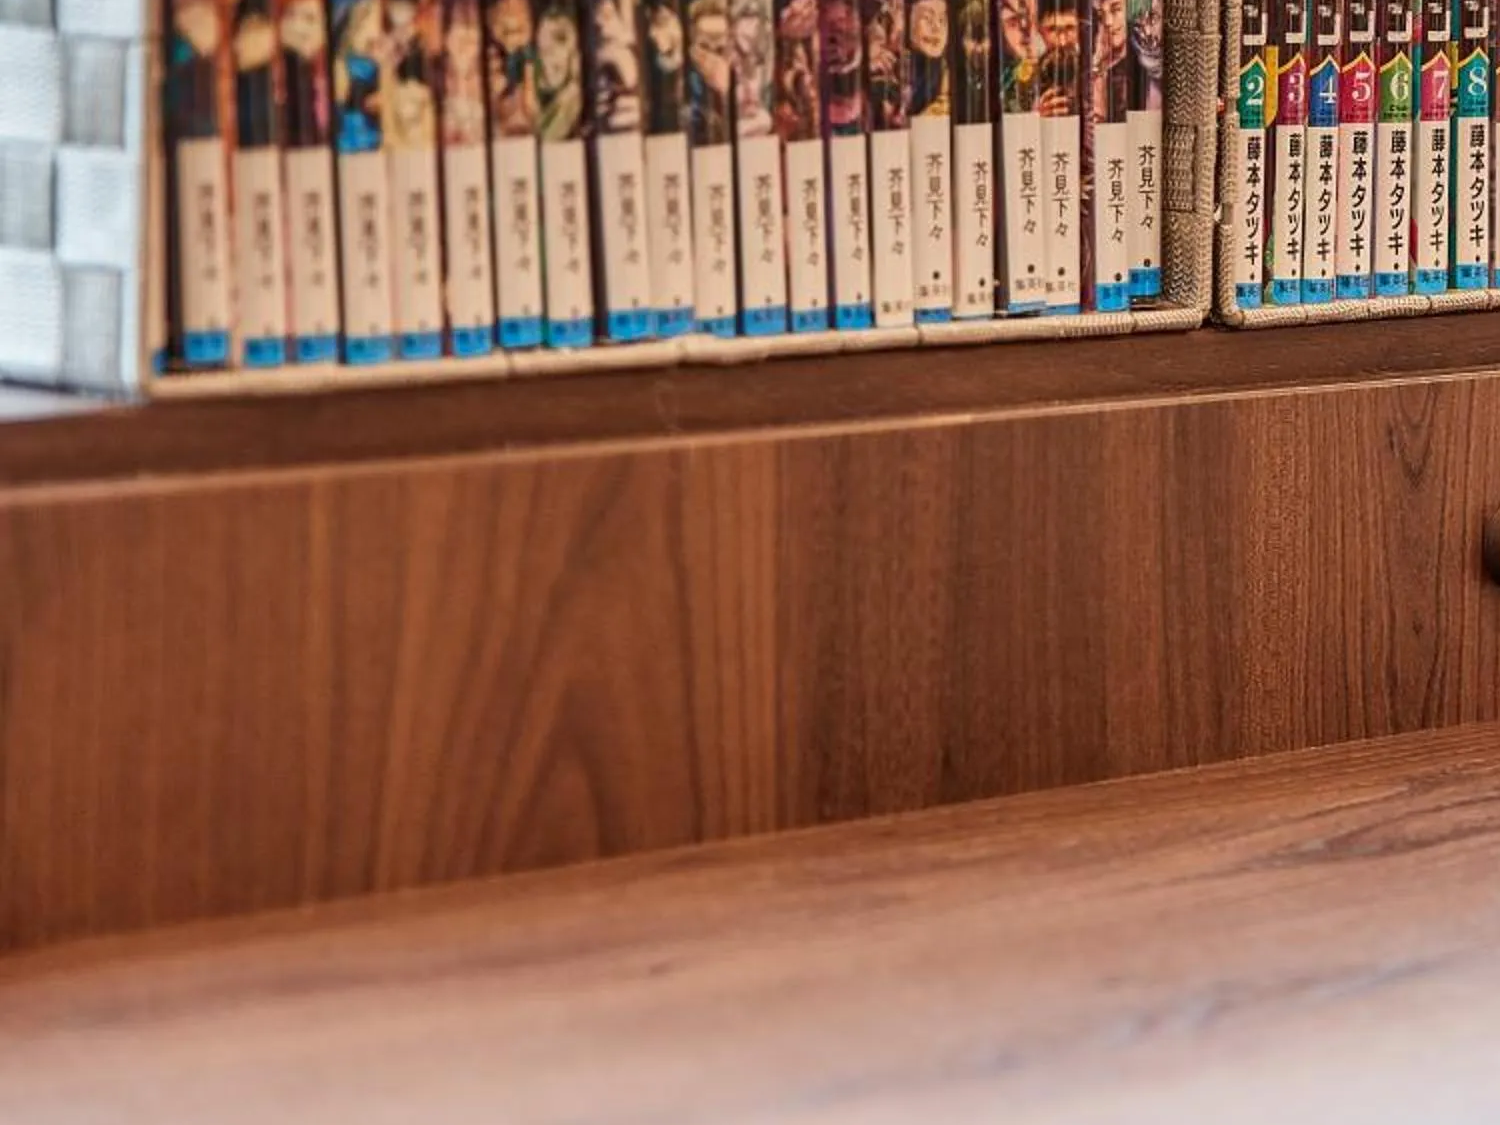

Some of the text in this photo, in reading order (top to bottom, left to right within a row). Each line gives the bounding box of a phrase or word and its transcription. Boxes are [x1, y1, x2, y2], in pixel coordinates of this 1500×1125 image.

[1247, 75, 1264, 105] 2
[1288, 72, 1304, 101] 3
[1319, 75, 1337, 103] 4
[1352, 71, 1371, 102] 5
[1390, 71, 1409, 101] 6
[1432, 70, 1449, 98] 7
[1467, 66, 1487, 95] 8
[926, 152, 943, 240] 芥見下々
[975, 161, 992, 247] 芥見下々
[1018, 148, 1036, 234] 芥見下々
[1052, 152, 1070, 238] 芥見下々
[1108, 158, 1125, 244] 芥見下々
[1138, 146, 1156, 230] 芥見下々
[1245, 137, 1261, 264] 藤本タツキ
[1317, 135, 1333, 261] 藤本タツキ
[1350, 131, 1368, 257] 藤本タツキ
[1388, 130, 1407, 255] 藤本タツキ
[1430, 128, 1446, 252] 藤本タツキ
[1469, 124, 1485, 248] 藤本タツキ
